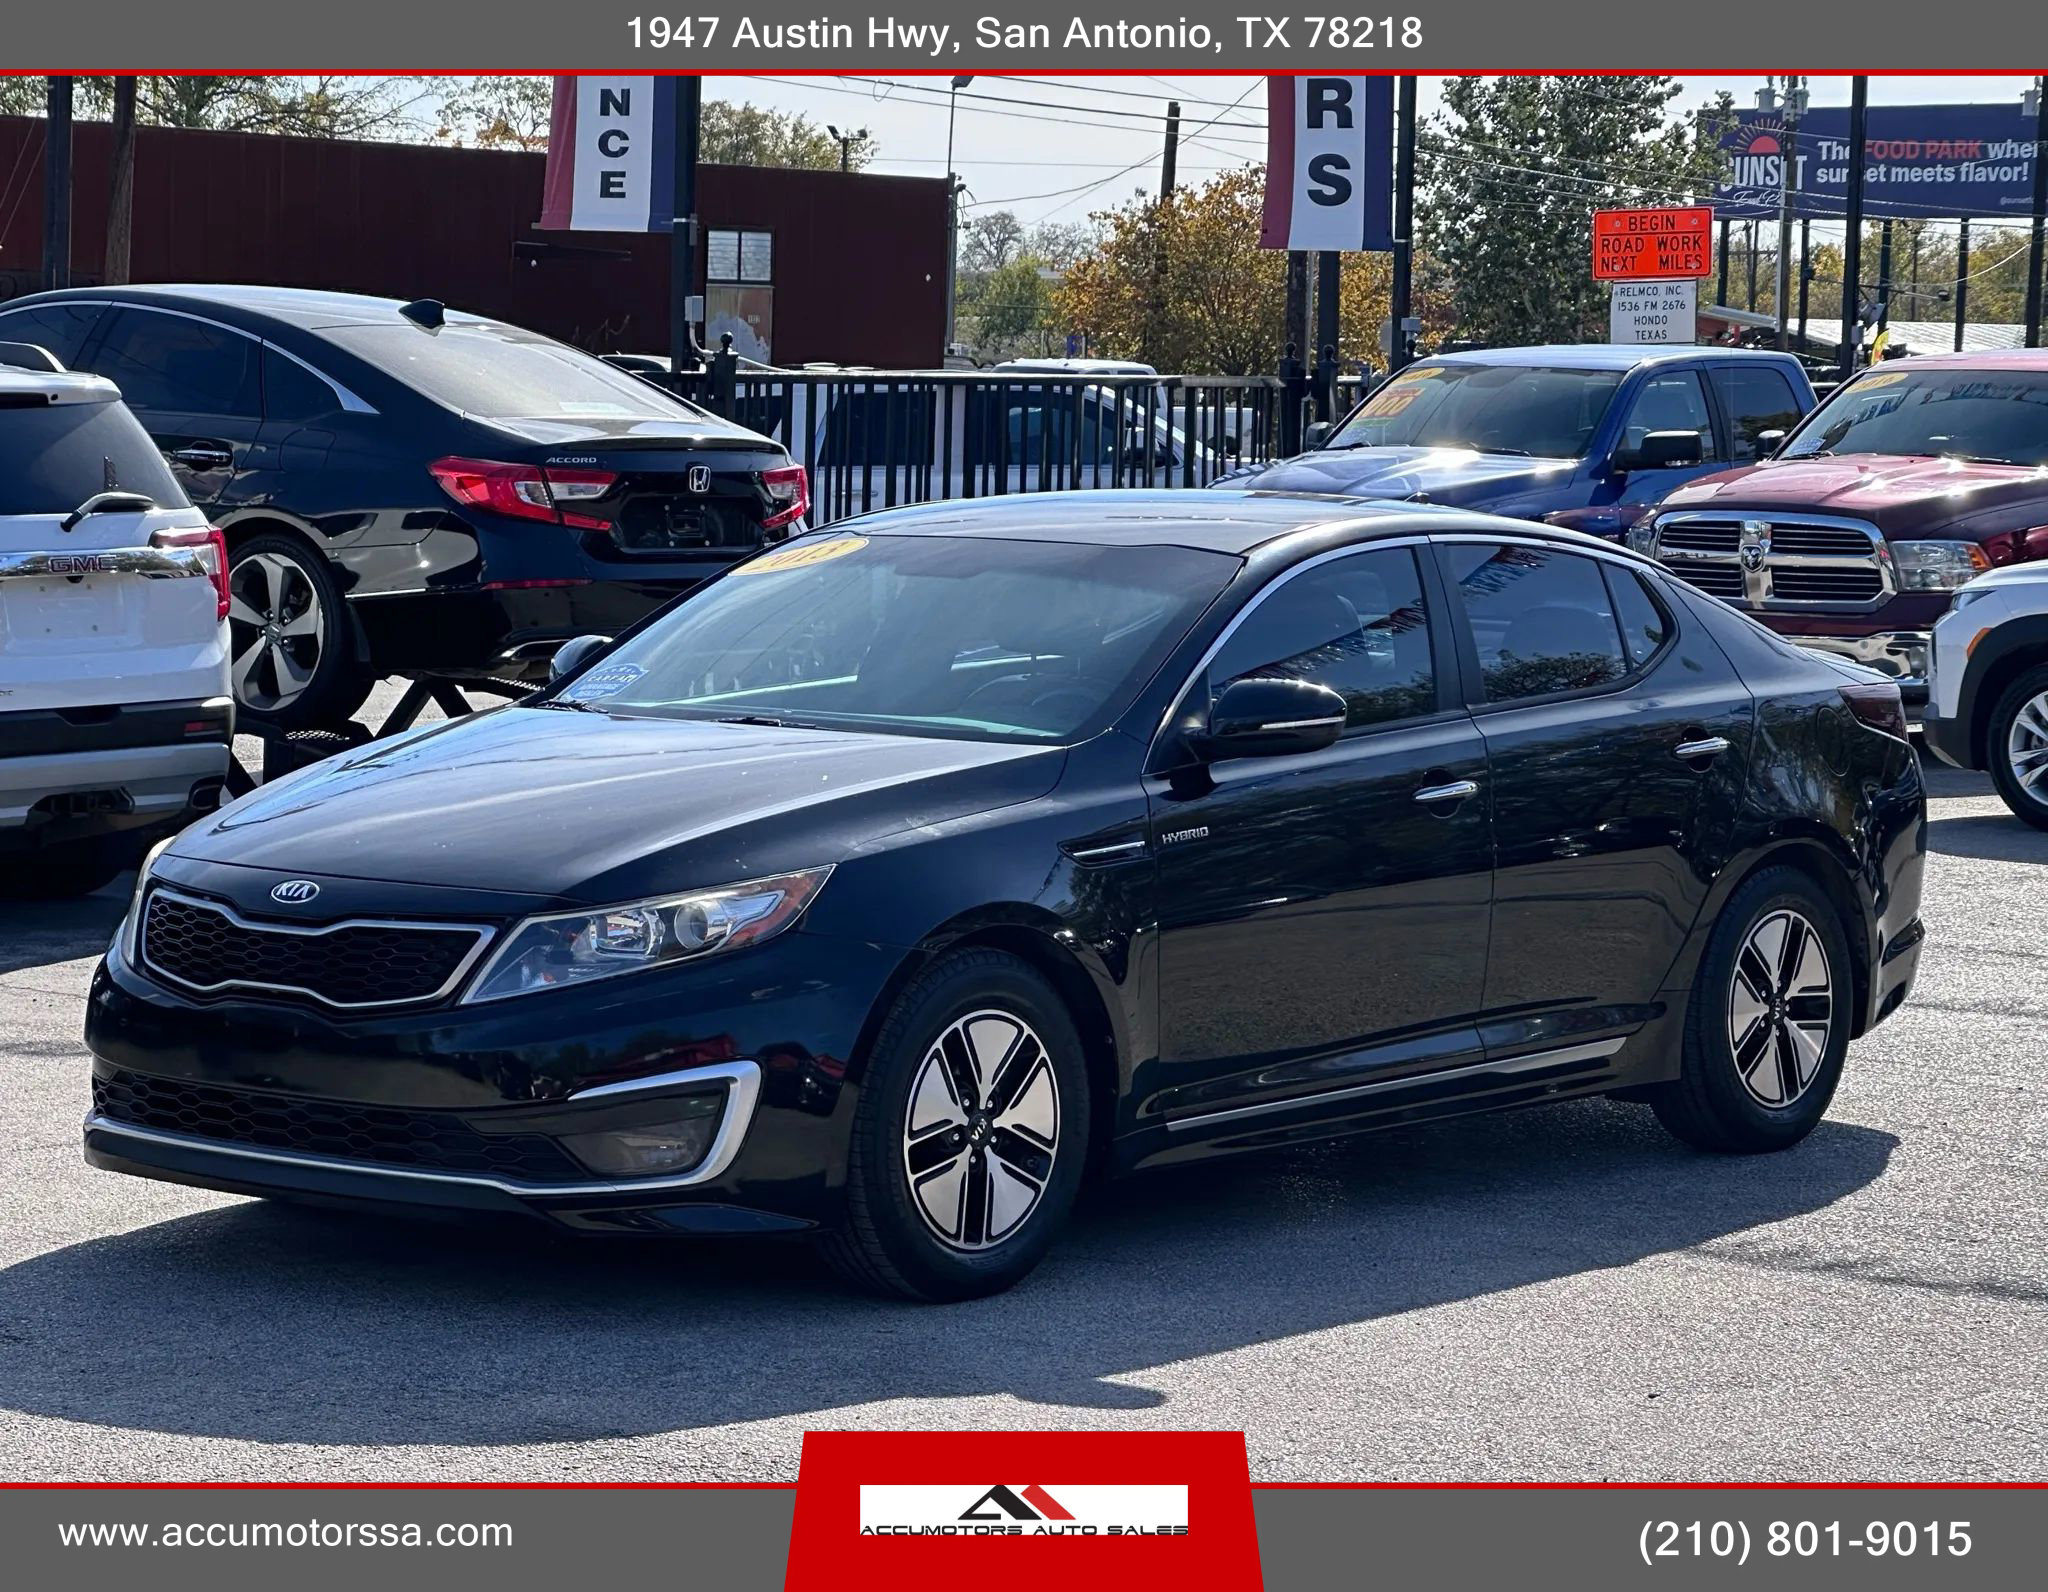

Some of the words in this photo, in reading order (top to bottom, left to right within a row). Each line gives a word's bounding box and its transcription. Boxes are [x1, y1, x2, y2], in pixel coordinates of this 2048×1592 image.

[1924, 140, 1982, 159] PARK
[1890, 164, 1957, 183] meets
[1959, 162, 2030, 183] flavor!
[1628, 214, 1676, 232] BEGIN
[1601, 237, 1645, 254] ROAD
[1657, 235, 1703, 252] WORK
[1601, 255, 1638, 273] NEXT
[1658, 253, 1703, 271] MILES
[1617, 302, 1640, 312] 1536
[1644, 301, 1658, 311] FM
[1662, 300, 1687, 311] 2676
[1633, 314, 1669, 326] HONDO
[1634, 329, 1668, 340] TEXAS
[545, 456, 598, 464] ACCORD
[48, 555, 118, 574] GMC
[1161, 826, 1209, 845] HYBRID
[275, 882, 312, 899] KIA
